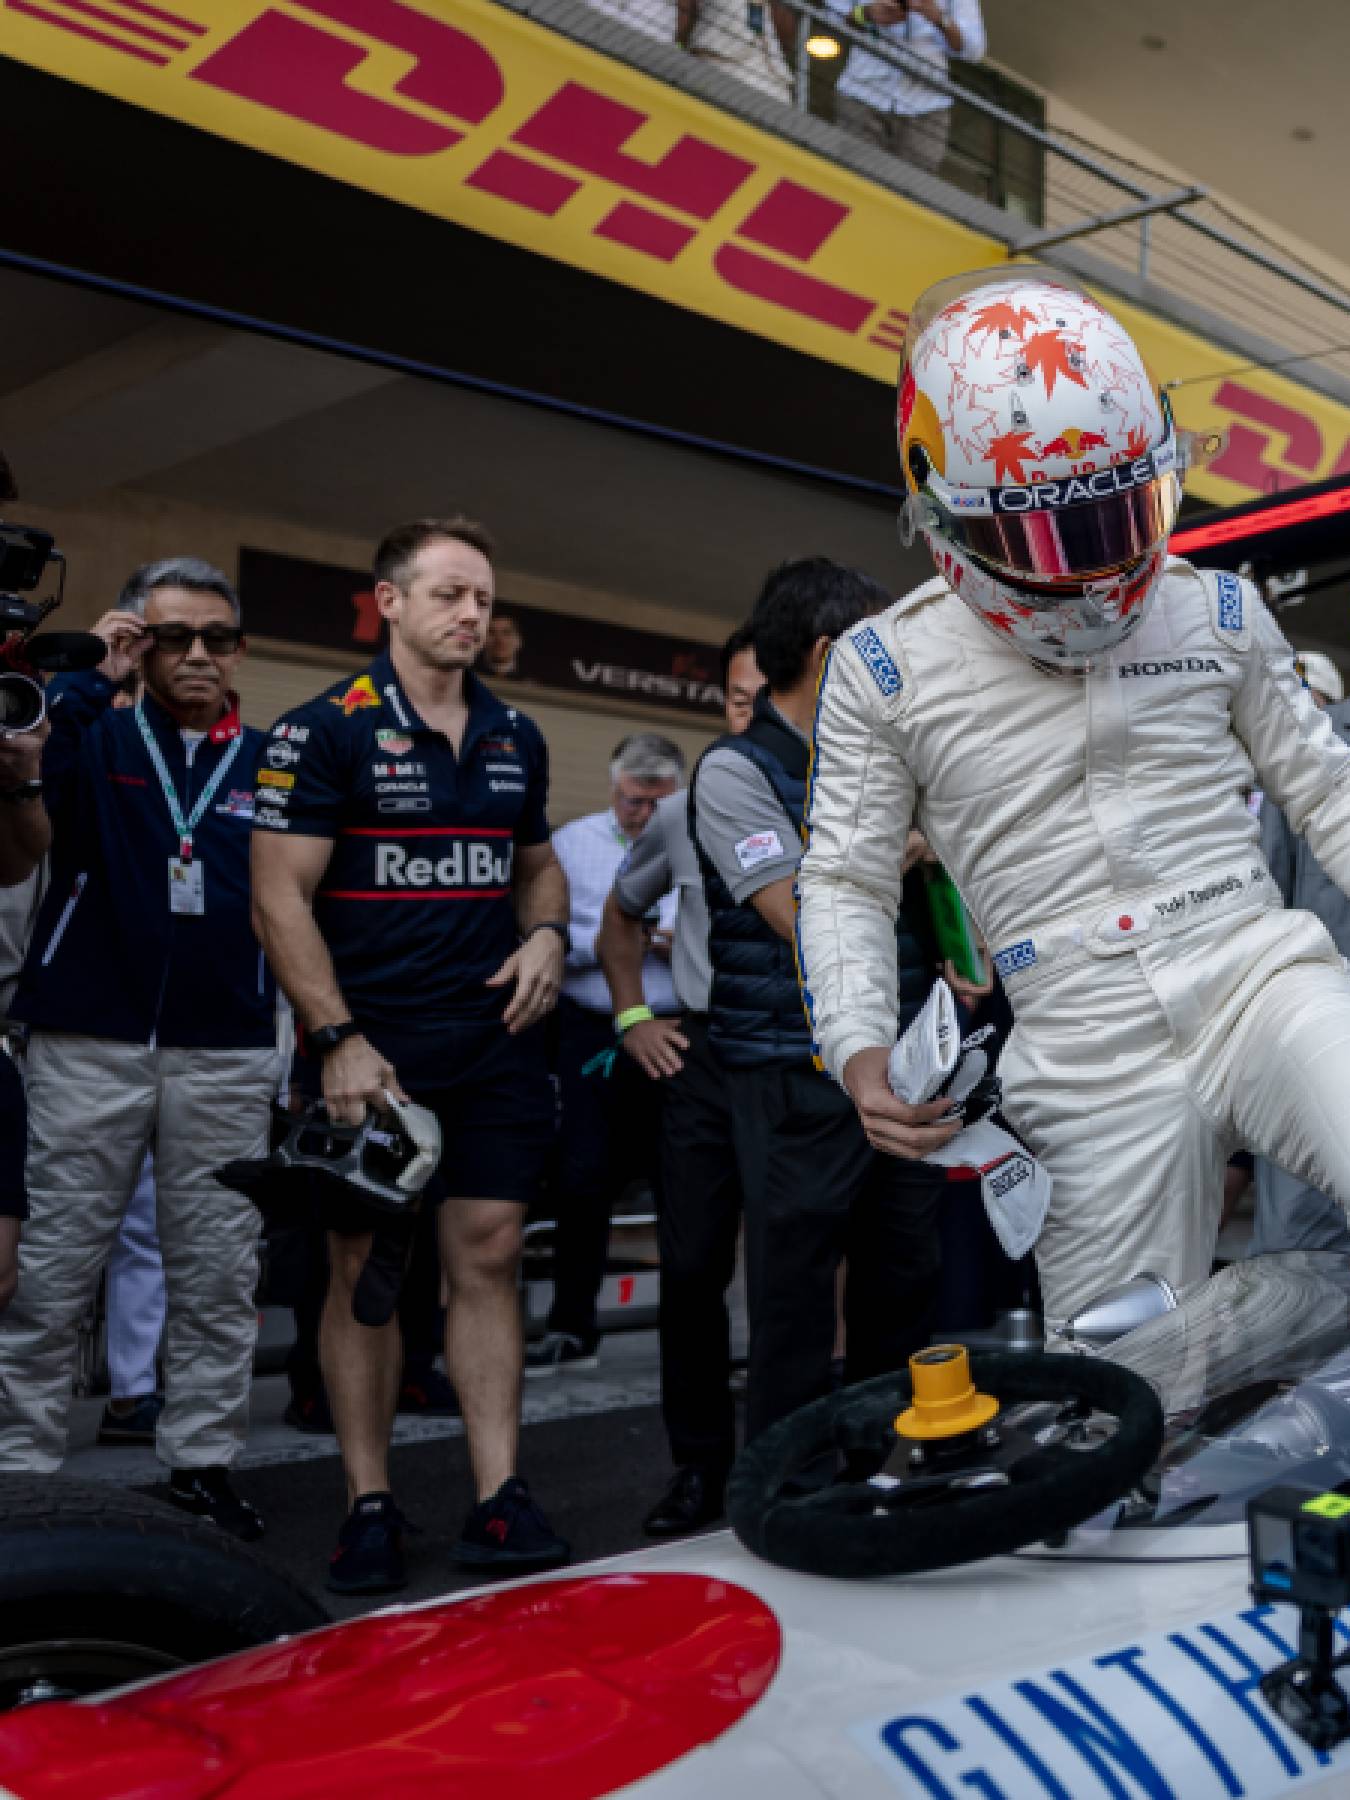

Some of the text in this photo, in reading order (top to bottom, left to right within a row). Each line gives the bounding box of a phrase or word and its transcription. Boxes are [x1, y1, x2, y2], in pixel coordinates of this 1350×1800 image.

[187, 0, 877, 335] DHL
[1000, 458, 1151, 512] ORACLE
[1119, 657, 1223, 678] HONDA
